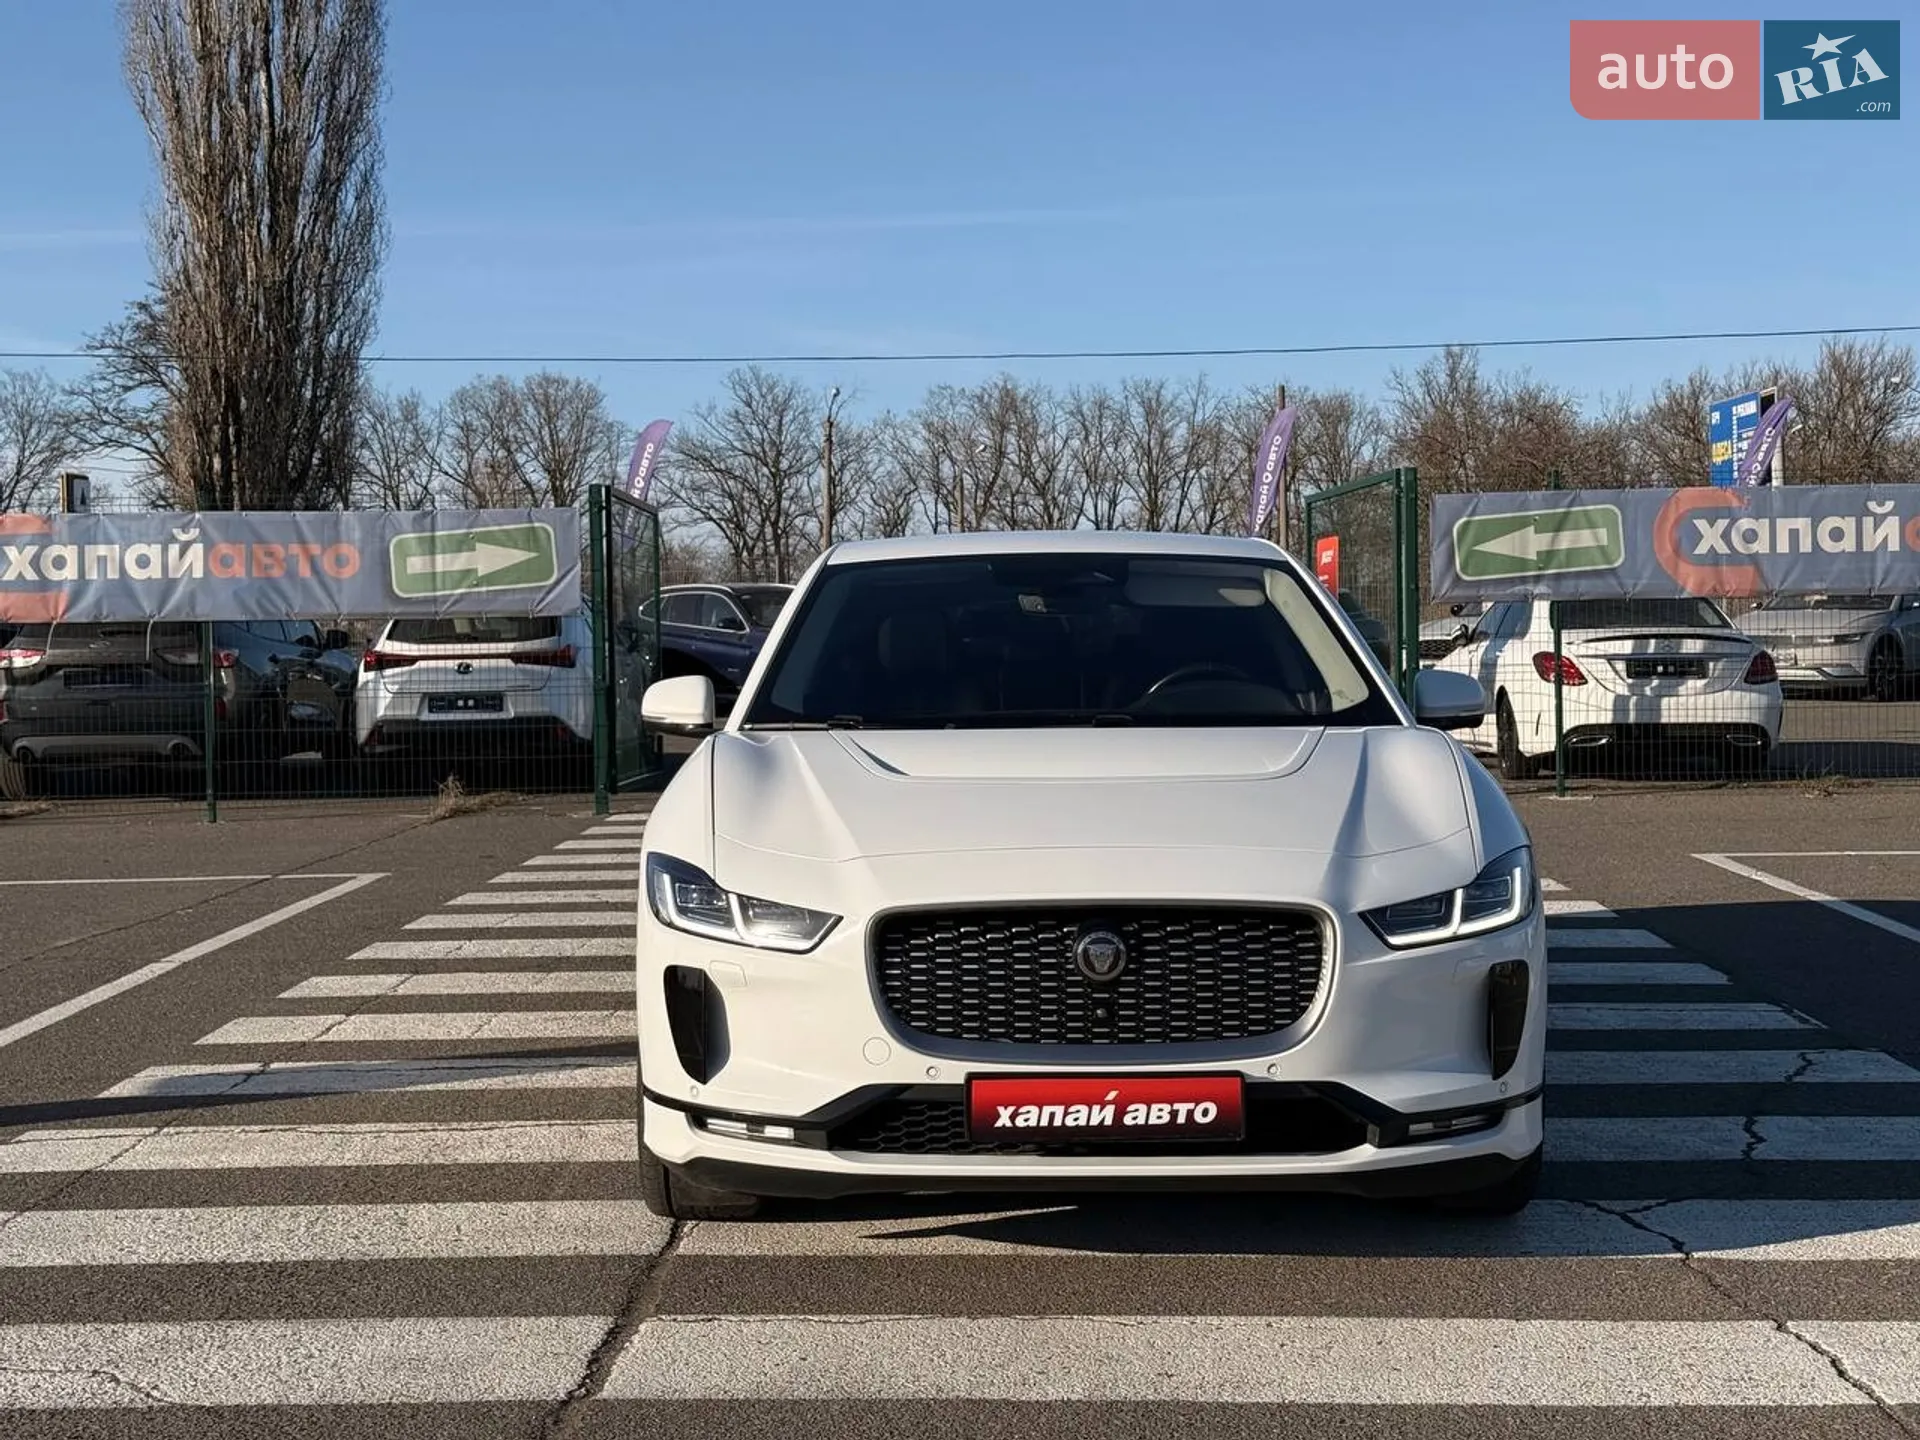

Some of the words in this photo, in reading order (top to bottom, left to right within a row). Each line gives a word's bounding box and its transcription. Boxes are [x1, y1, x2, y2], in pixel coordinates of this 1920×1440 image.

[638, 442, 654, 477] авто
[1266, 435, 1282, 472] авто
[1123, 1102, 1218, 1126] авто
